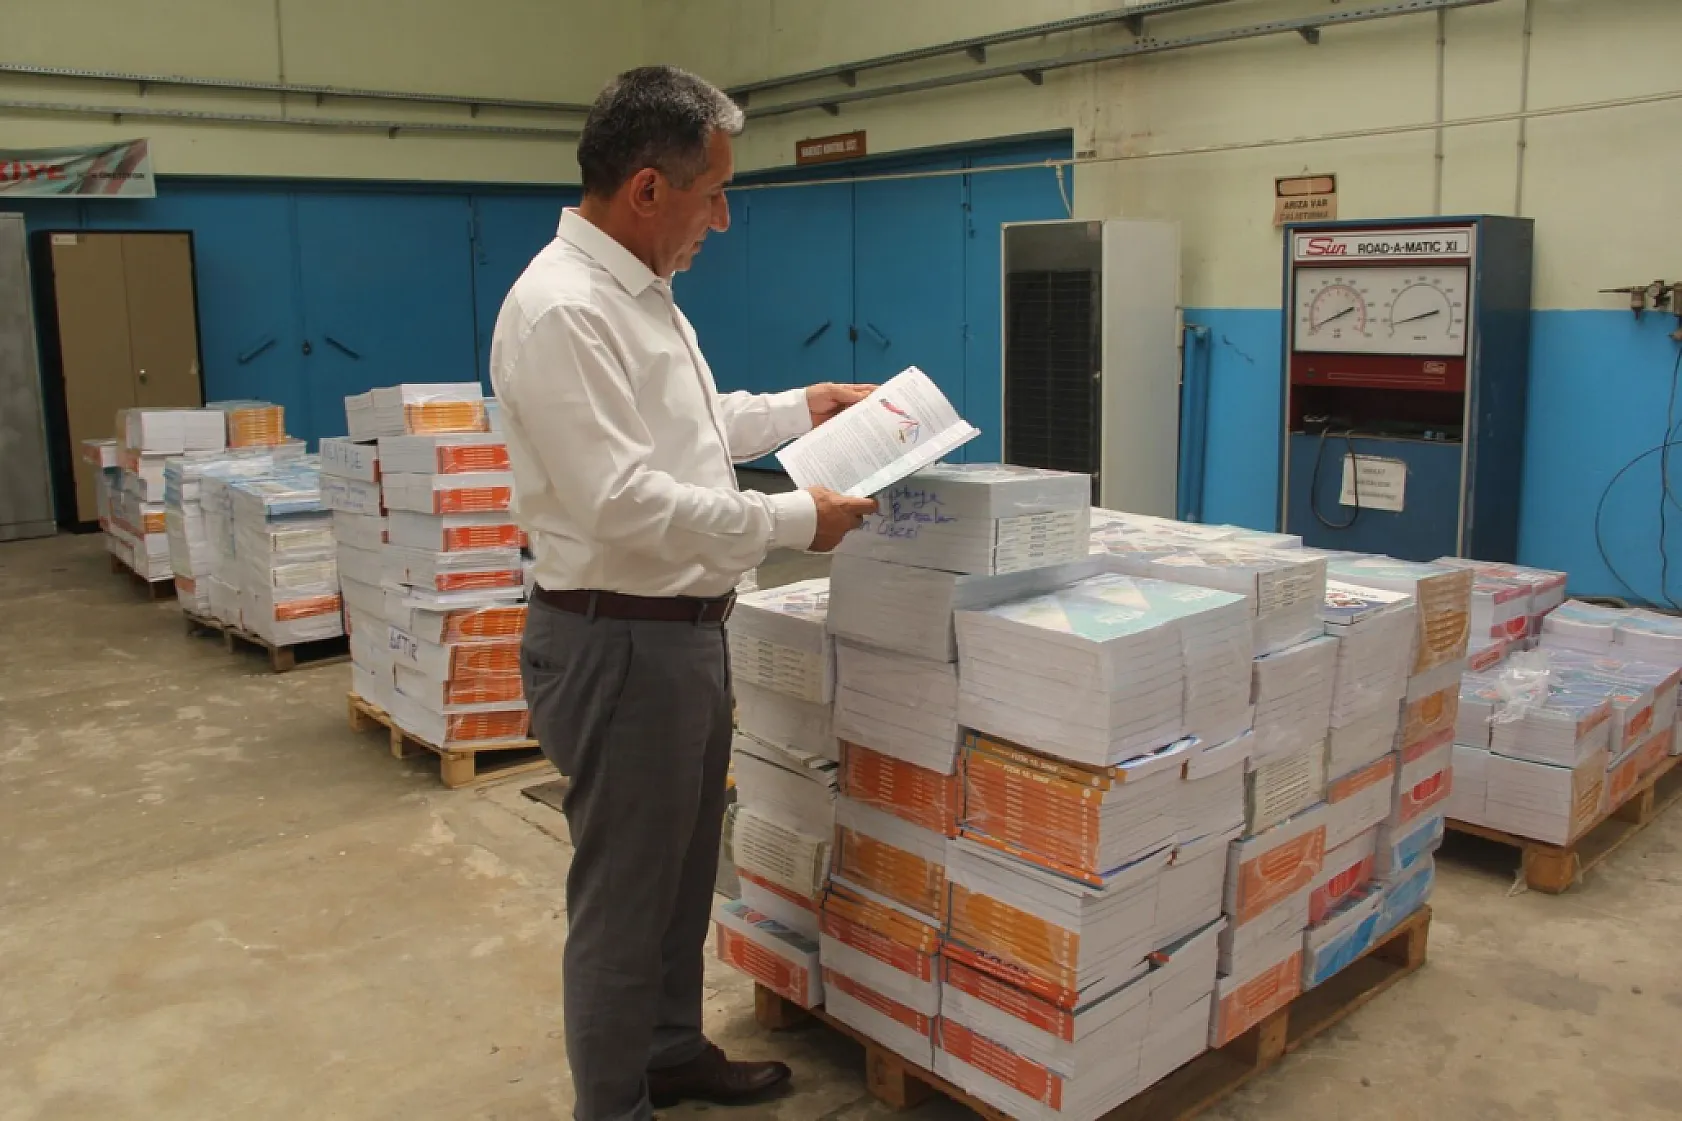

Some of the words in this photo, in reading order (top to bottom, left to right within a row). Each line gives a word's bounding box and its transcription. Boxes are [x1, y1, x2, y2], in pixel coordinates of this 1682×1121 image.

[1310, 198, 1328, 208] VAR
[1306, 237, 1347, 256] Sun
[1445, 240, 1458, 251] XI
